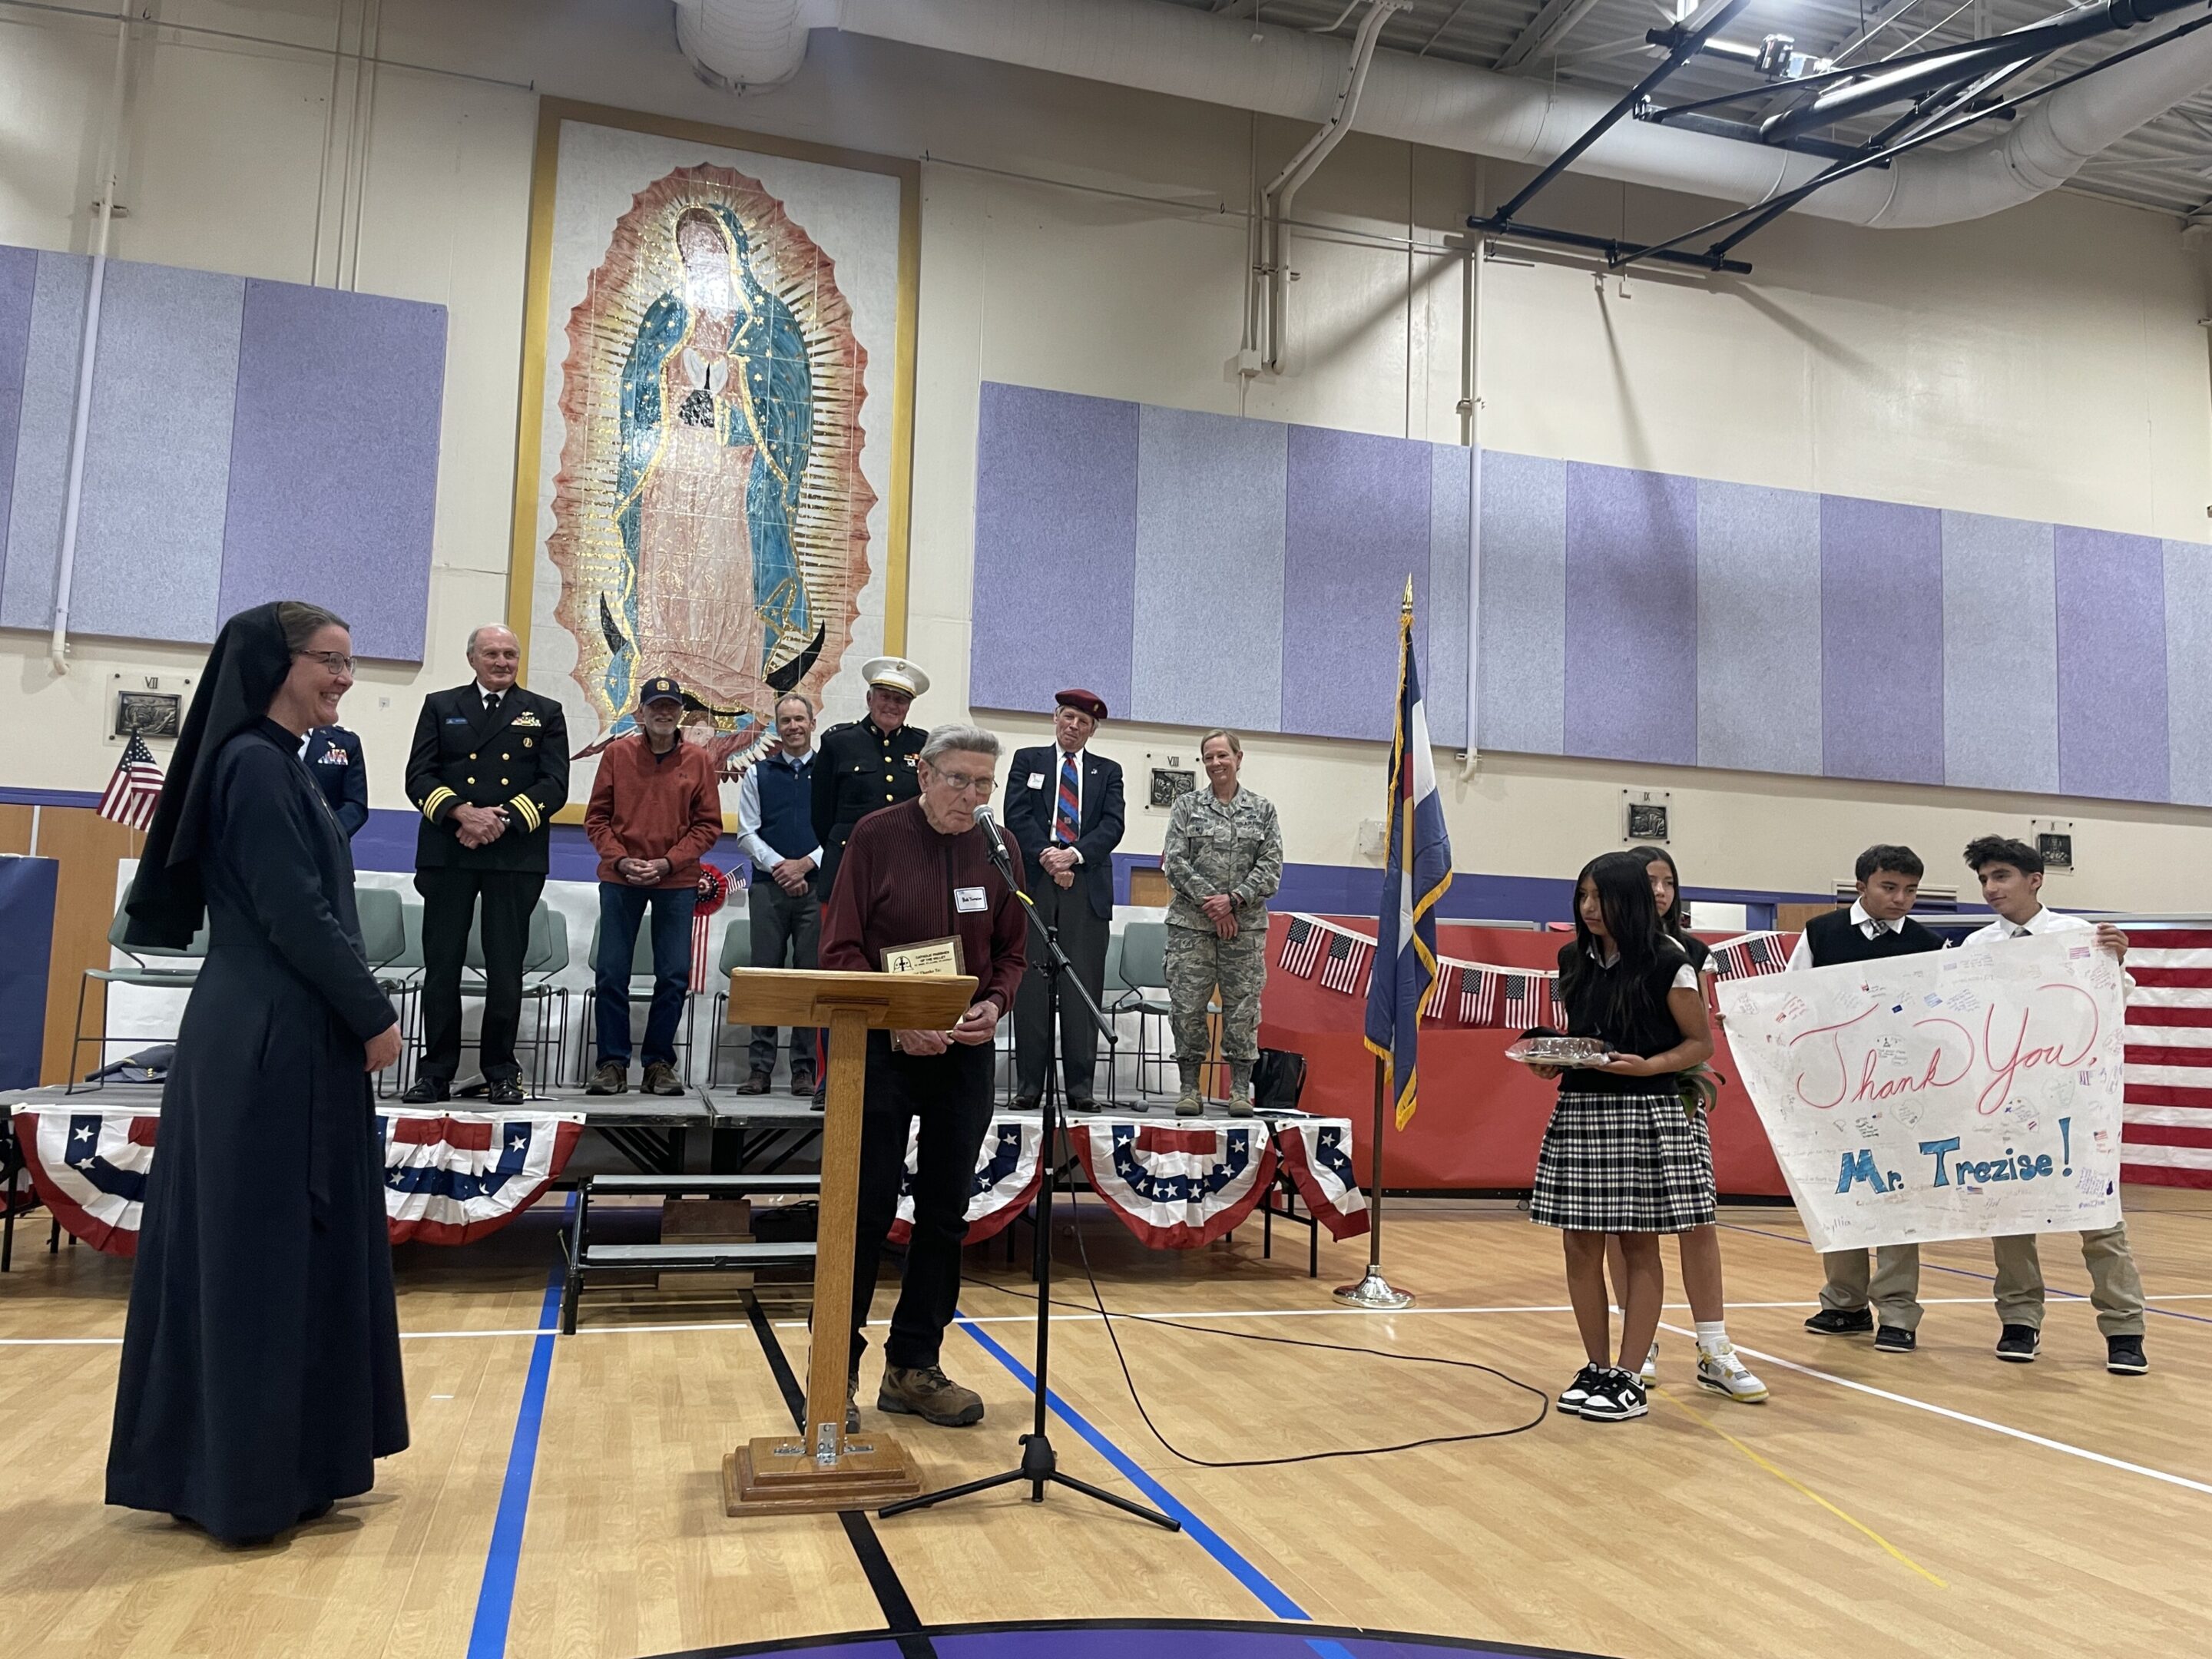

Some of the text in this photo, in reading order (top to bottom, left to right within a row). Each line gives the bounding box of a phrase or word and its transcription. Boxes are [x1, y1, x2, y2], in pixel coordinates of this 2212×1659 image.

[145, 677, 158, 689] VII
[1167, 756, 1180, 767] VIII
[1789, 1002, 1975, 1108] Thank
[1835, 1149, 1904, 1194] Mr.
[1918, 1117, 2073, 1187] Trezise!
